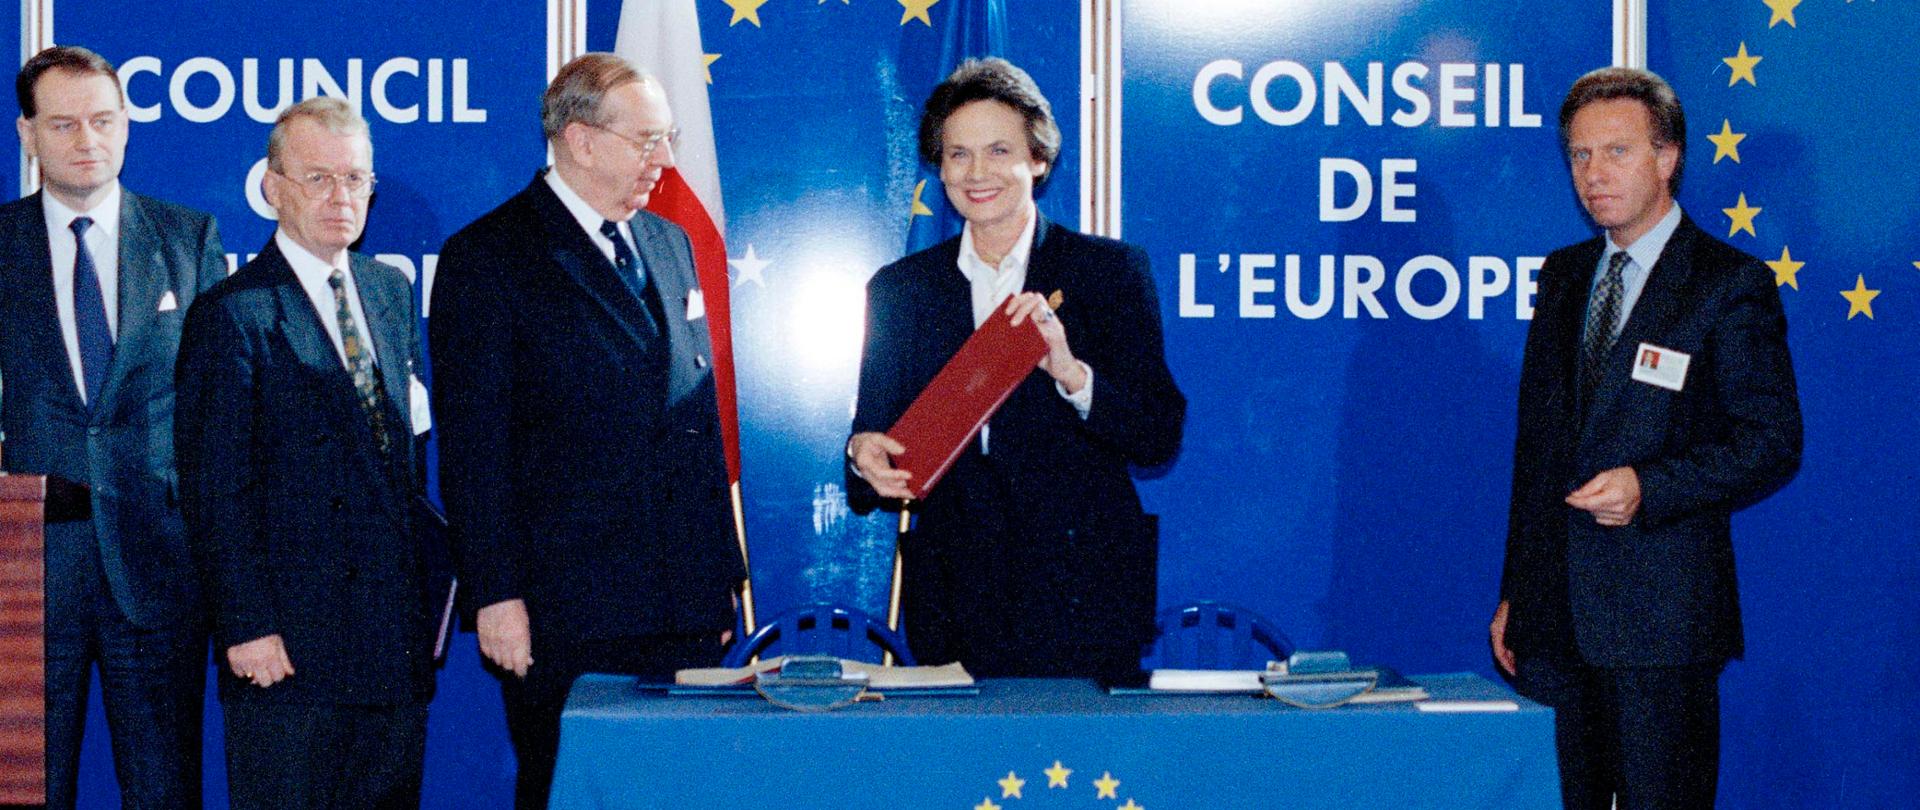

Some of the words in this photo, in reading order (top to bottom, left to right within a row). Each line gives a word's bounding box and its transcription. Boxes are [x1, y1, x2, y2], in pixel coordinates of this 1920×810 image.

[116, 56, 487, 123] COUNCIL
[1193, 60, 1542, 127] CONSEIL
[1319, 158, 1417, 222] DE
[1178, 253, 1547, 320] L'EUROPE
